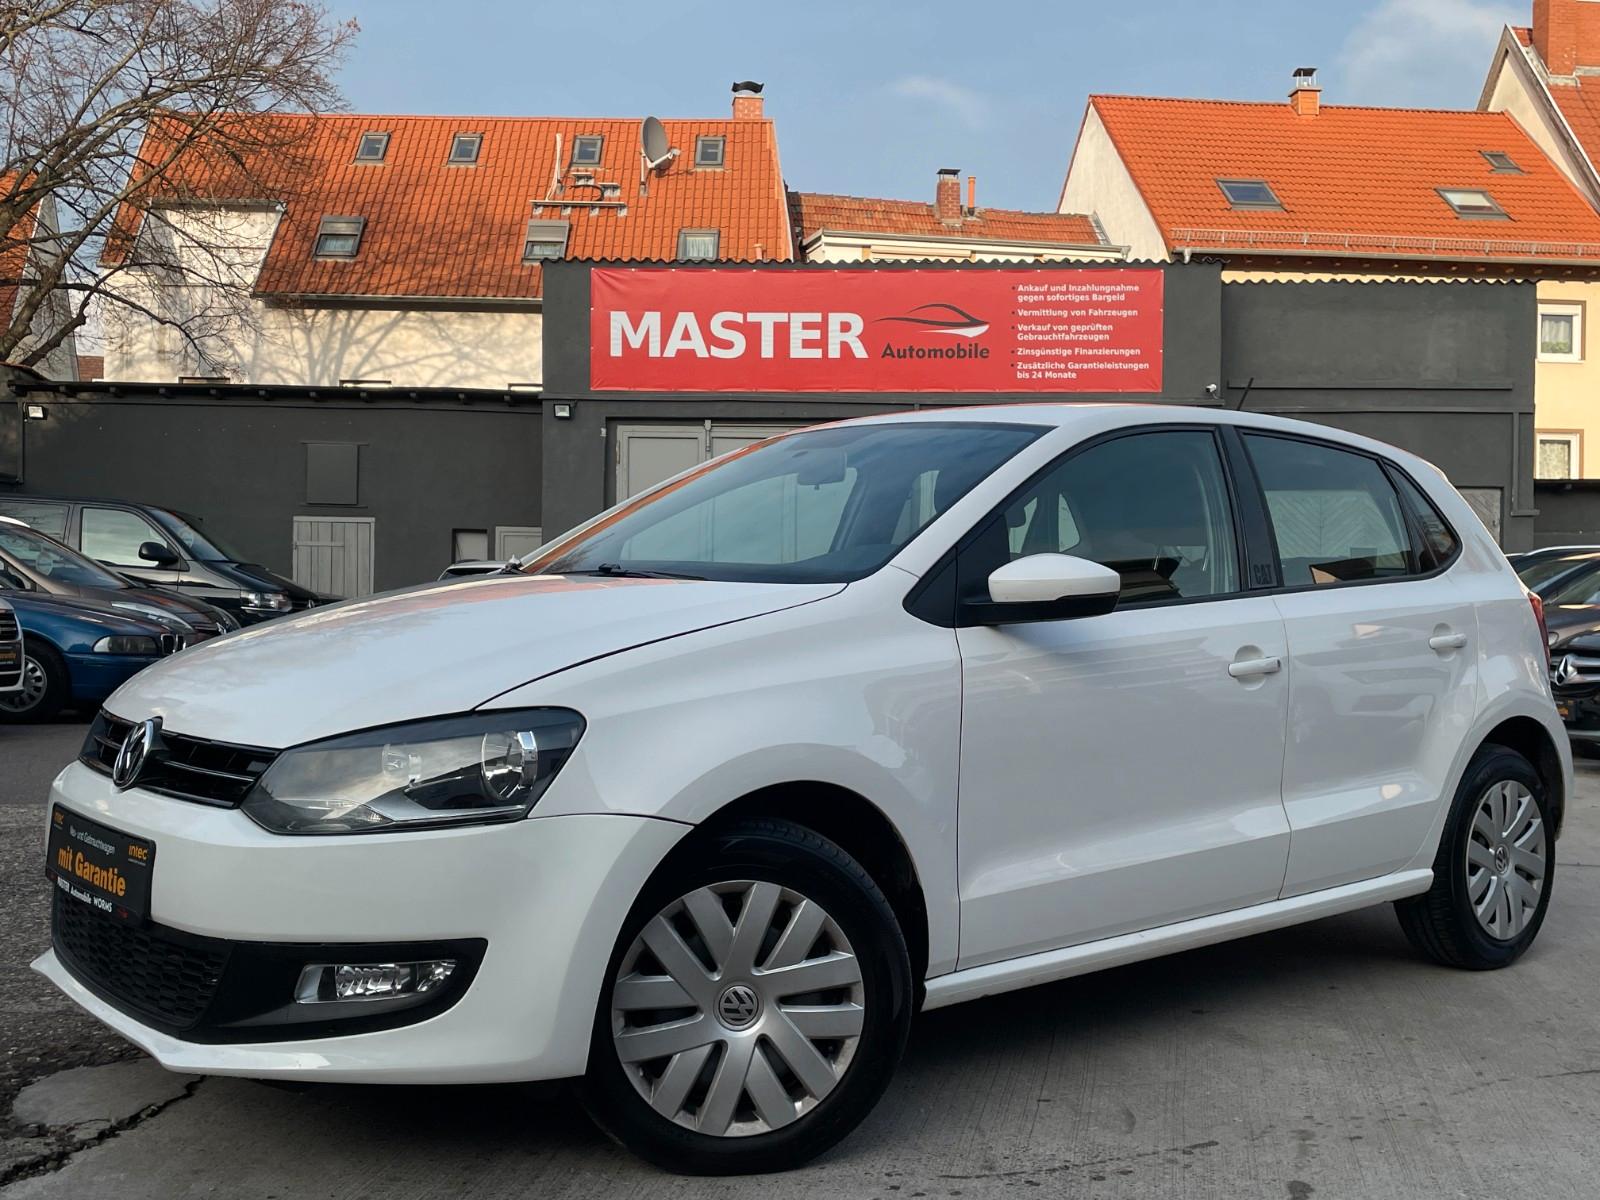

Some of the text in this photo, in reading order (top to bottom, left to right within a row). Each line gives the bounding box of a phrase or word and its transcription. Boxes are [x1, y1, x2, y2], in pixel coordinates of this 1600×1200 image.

[1018, 284, 1139, 294] Ankauf und Inzahlungnahme
[1018, 293, 1125, 302] gegen sofortiges Bargeld
[1018, 309, 1068, 318] Vermittlung
[1088, 308, 1138, 318] Fahrzeugen
[1018, 324, 1051, 332] Verkauf
[1071, 323, 1113, 333] geprüften
[609, 311, 868, 359] MASTER
[1017, 333, 1110, 342] Gebrauchtfahrzeugen
[881, 342, 990, 359] Automobile
[1017, 347, 1141, 357] Zinsgünstige Finanzierungen
[1017, 361, 1150, 371] Zusätzliche Garantieleistungen
[1017, 371, 1077, 379] bis 24 Monate
[58, 845, 126, 897] mit Garantie
[93, 896, 113, 913] WORMS
